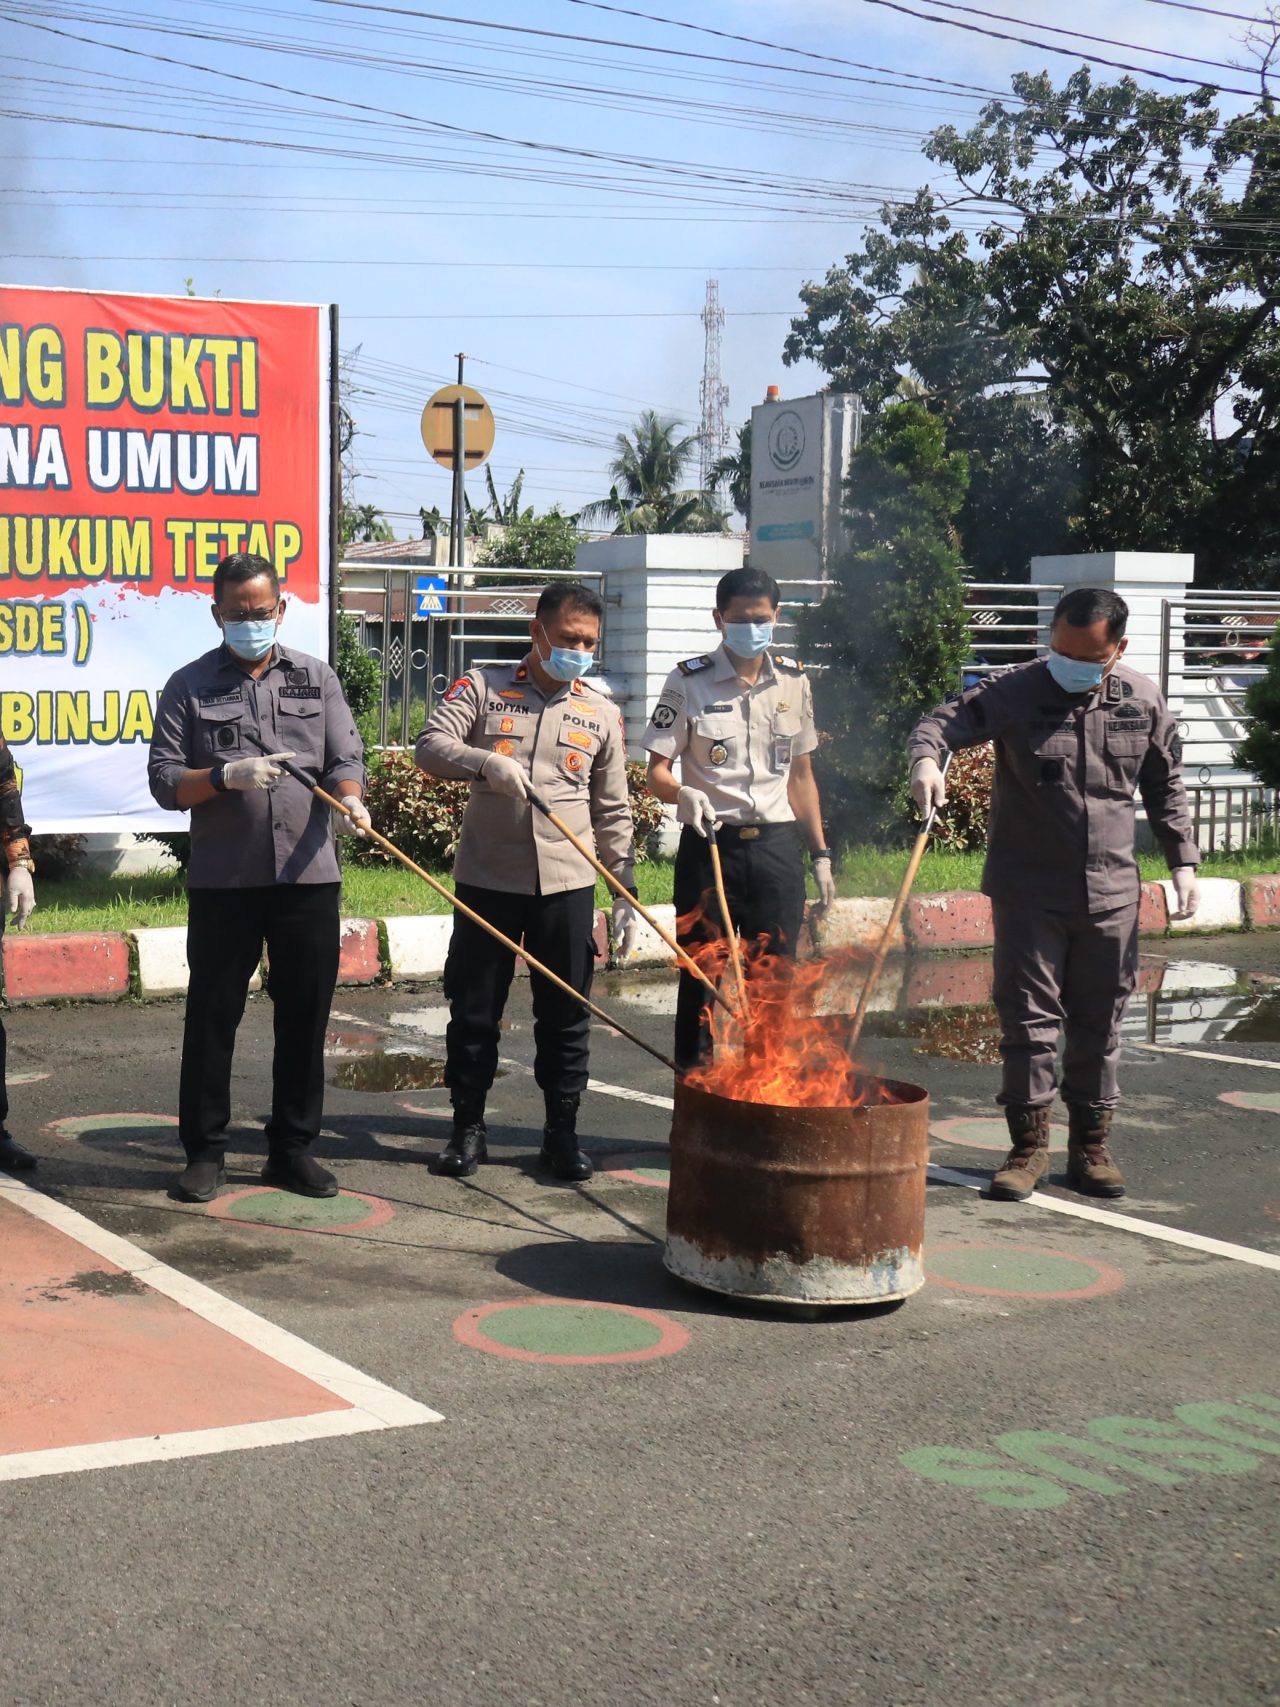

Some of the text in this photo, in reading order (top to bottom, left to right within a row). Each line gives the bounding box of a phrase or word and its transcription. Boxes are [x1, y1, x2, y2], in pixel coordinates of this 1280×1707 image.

[85, 330, 260, 414] BUKTI
[86, 430, 261, 494] UMUM
[165, 519, 303, 580] TETAP
[0, 690, 162, 744] BINJA
[488, 701, 529, 715] SOFYAN
[562, 713, 601, 732] POLRI
